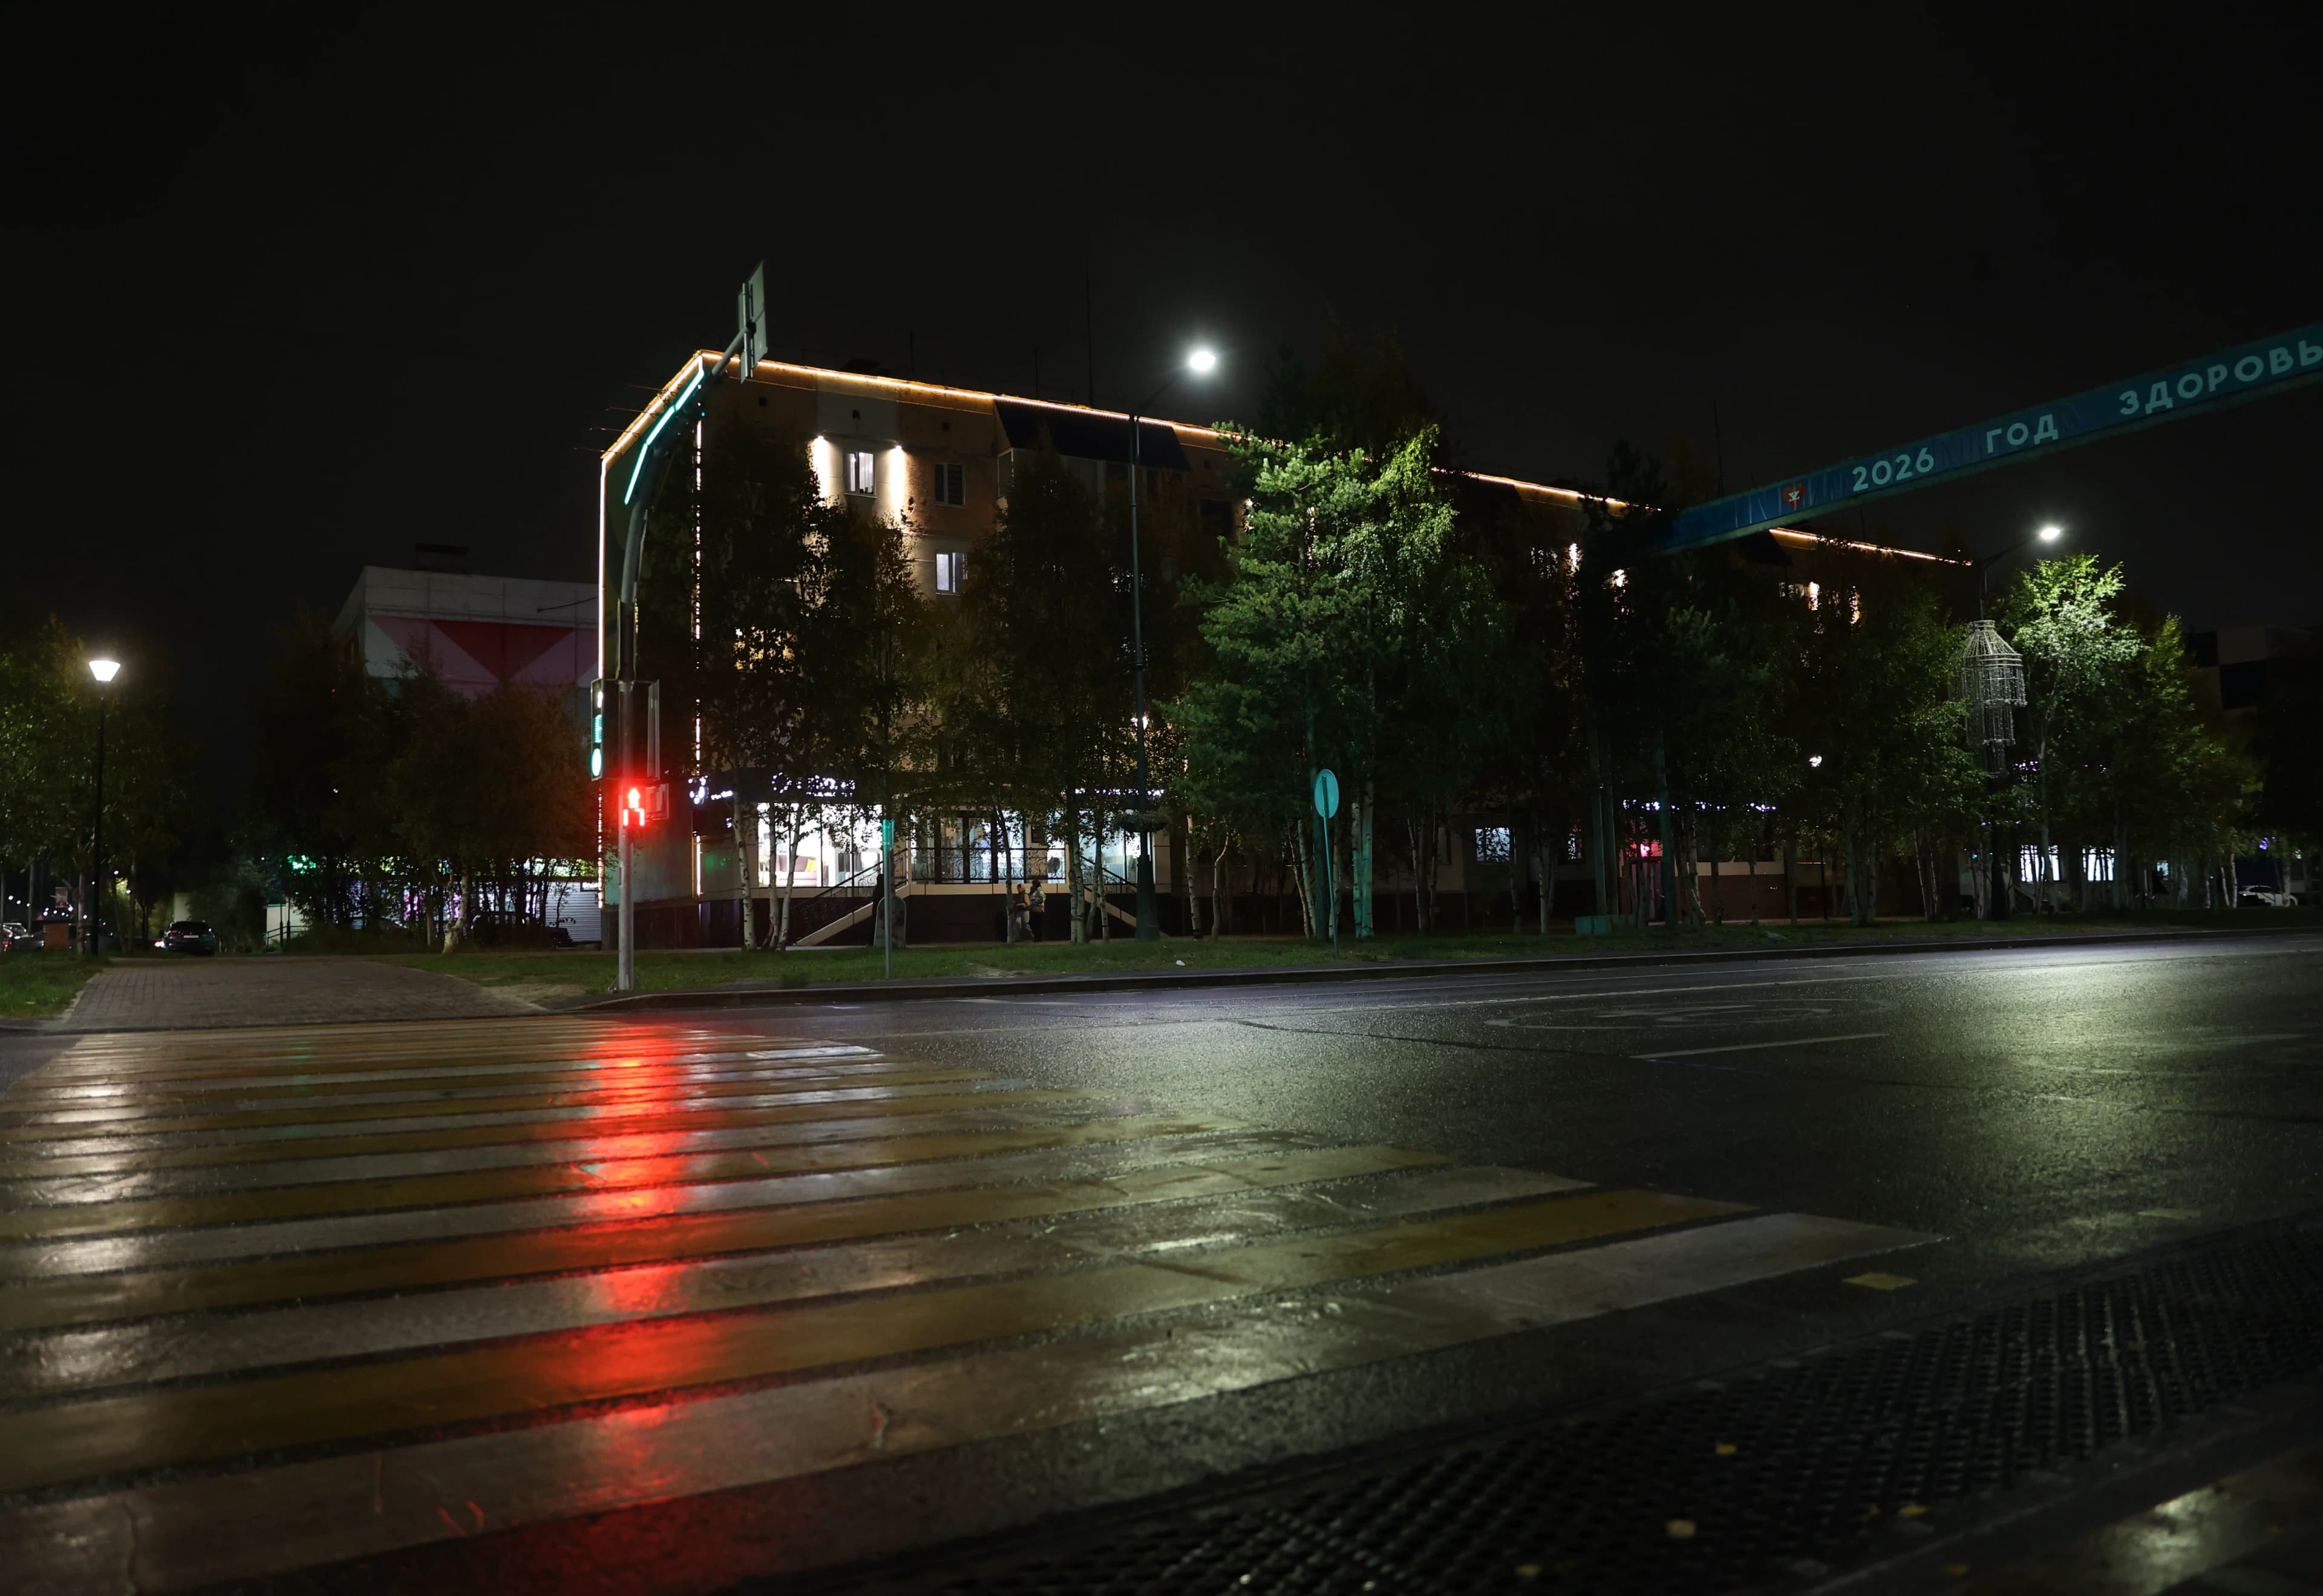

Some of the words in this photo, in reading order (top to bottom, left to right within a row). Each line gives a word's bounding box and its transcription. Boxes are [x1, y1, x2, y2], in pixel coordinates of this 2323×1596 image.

[1852, 447, 1934, 492] 2026
[1985, 414, 2058, 453] ГОД
[2119, 339, 2323, 414] ЗДОРОВЬ
